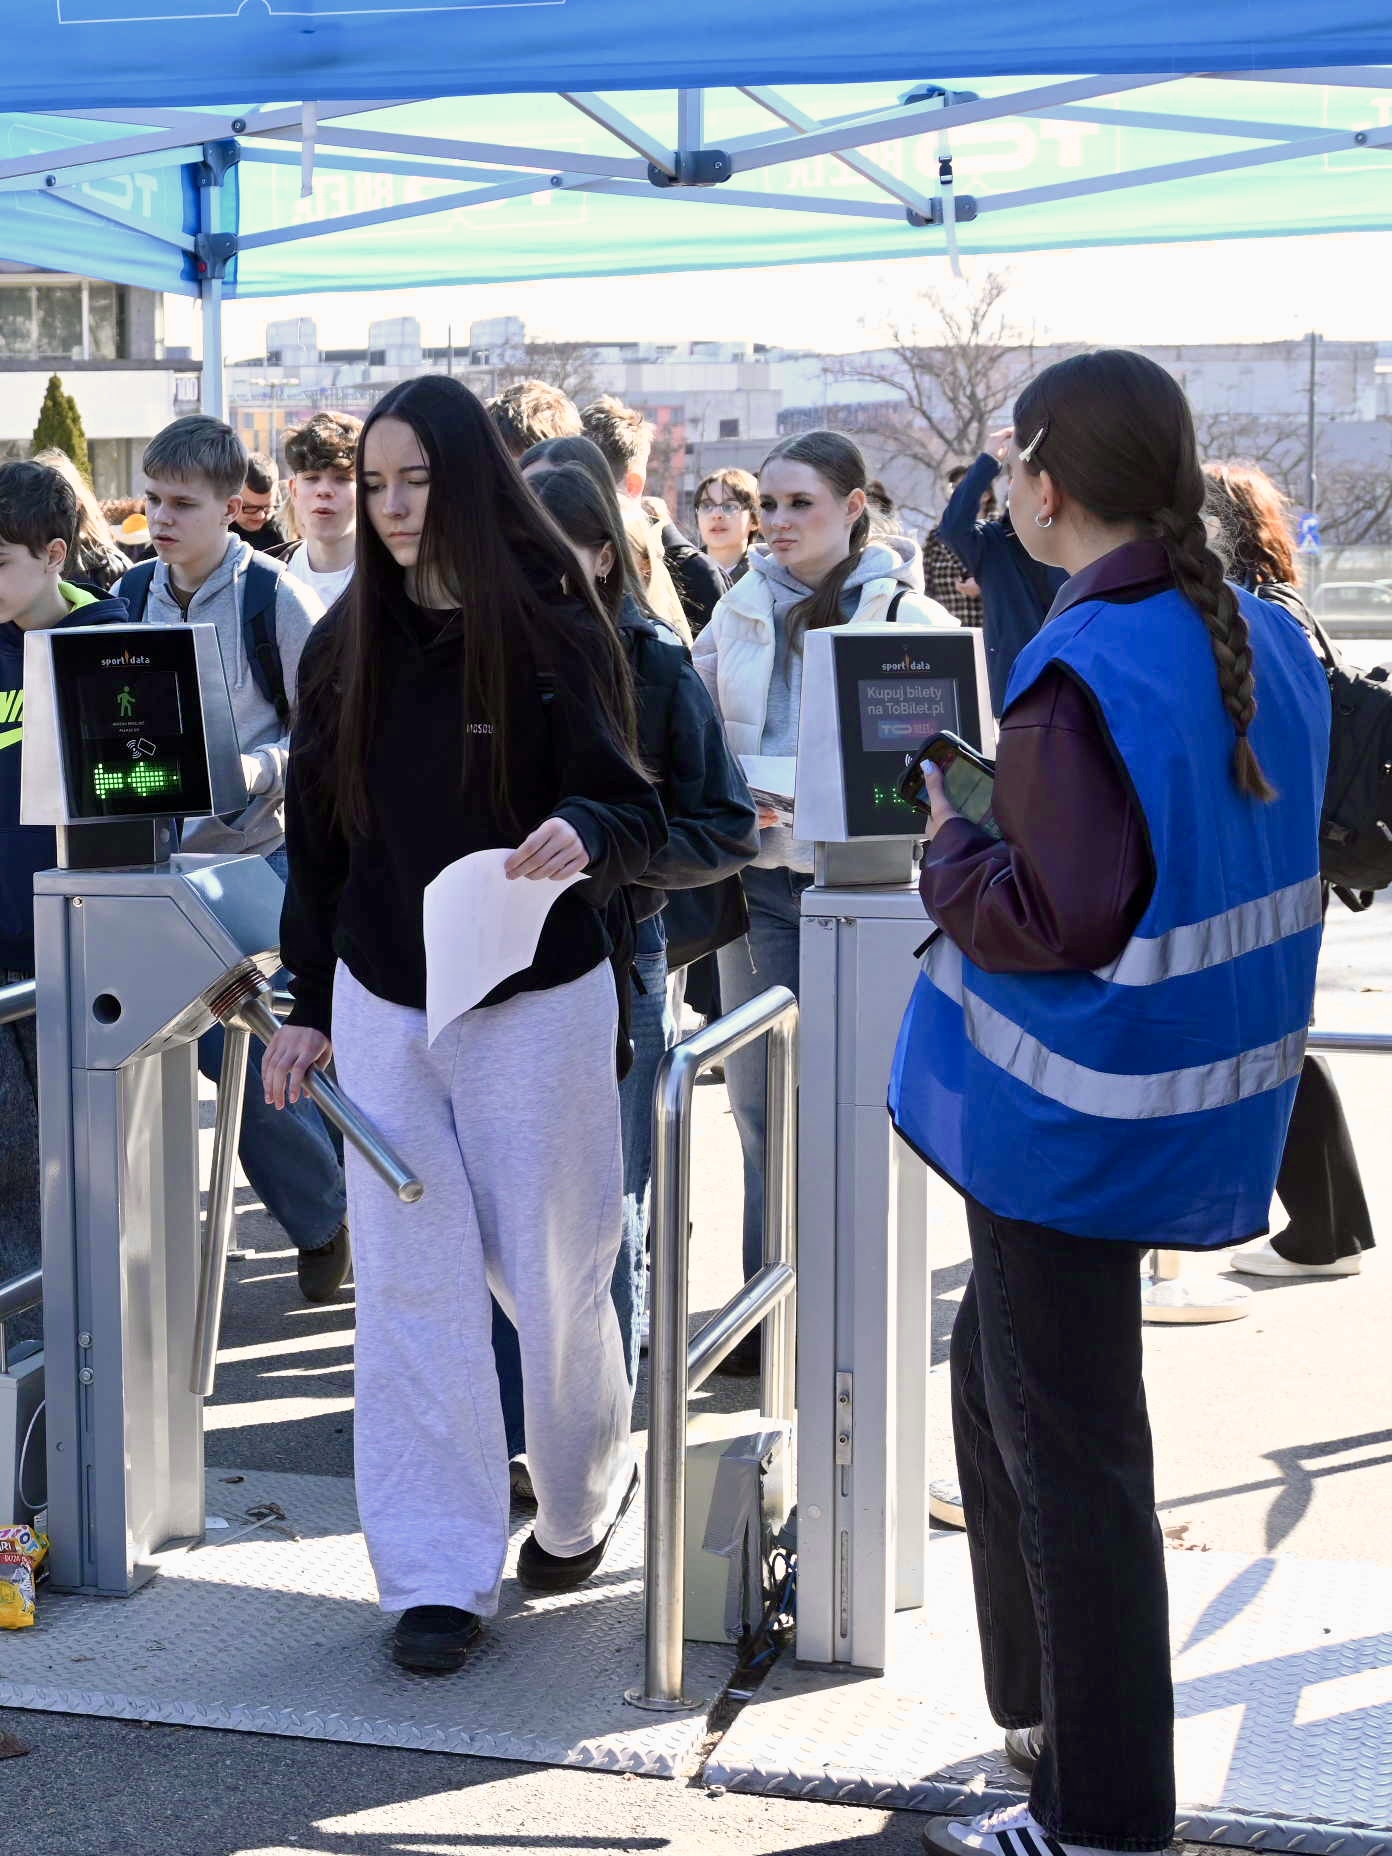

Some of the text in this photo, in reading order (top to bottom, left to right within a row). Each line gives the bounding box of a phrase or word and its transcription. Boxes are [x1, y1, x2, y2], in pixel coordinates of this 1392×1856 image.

[100, 656, 151, 667] sport data
[881, 660, 931, 672] sport data
[867, 686, 943, 701] Kupuj bilety
[868, 702, 945, 717] na ToBilet.pl
